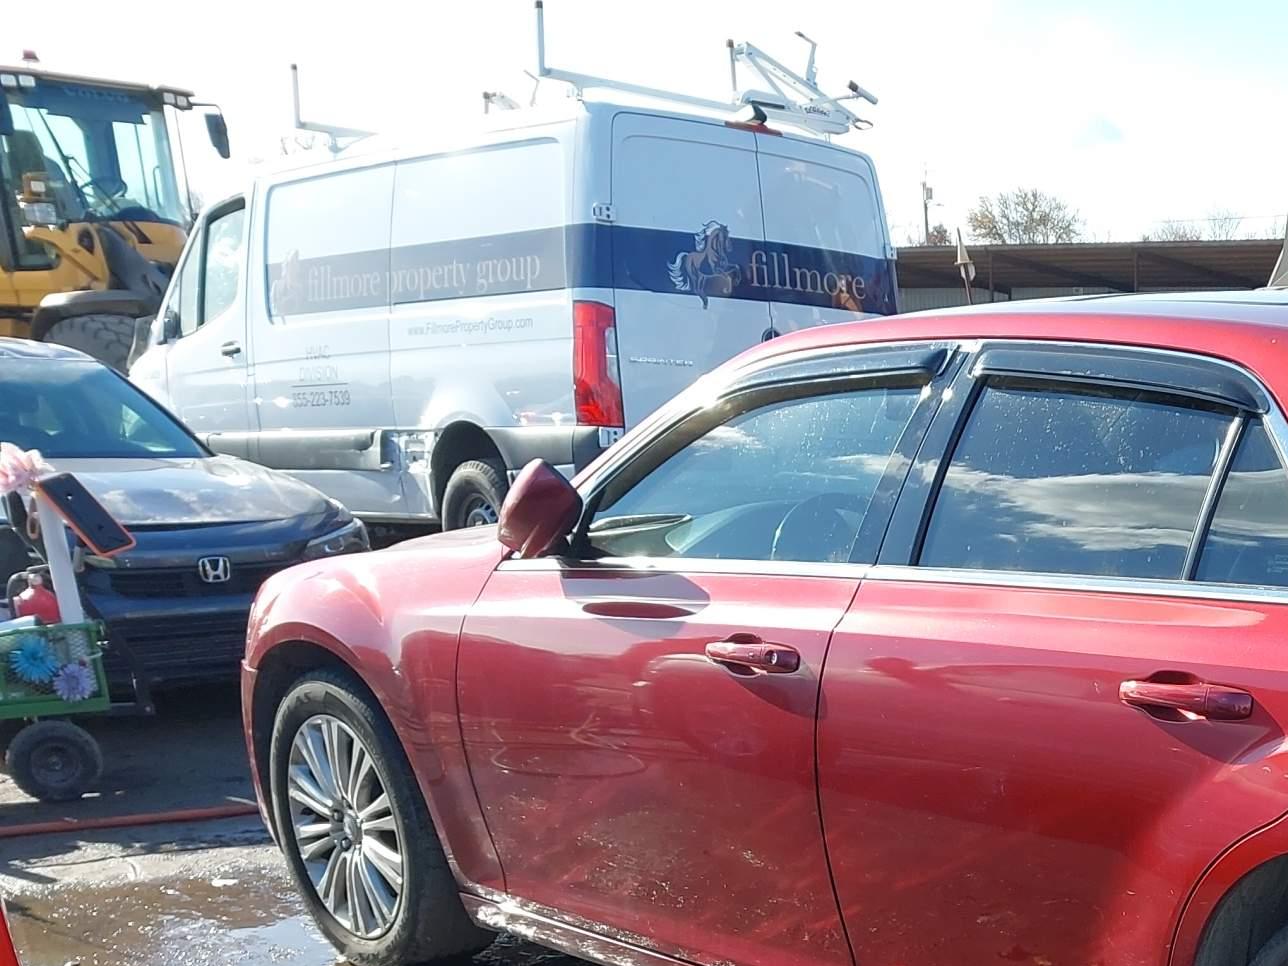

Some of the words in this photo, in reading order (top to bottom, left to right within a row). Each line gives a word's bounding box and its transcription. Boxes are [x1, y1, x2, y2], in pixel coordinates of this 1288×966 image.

[307, 264, 381, 300] fillmore
[386, 260, 469, 299] property
[475, 256, 541, 289] group
[749, 251, 866, 299] fillmore
